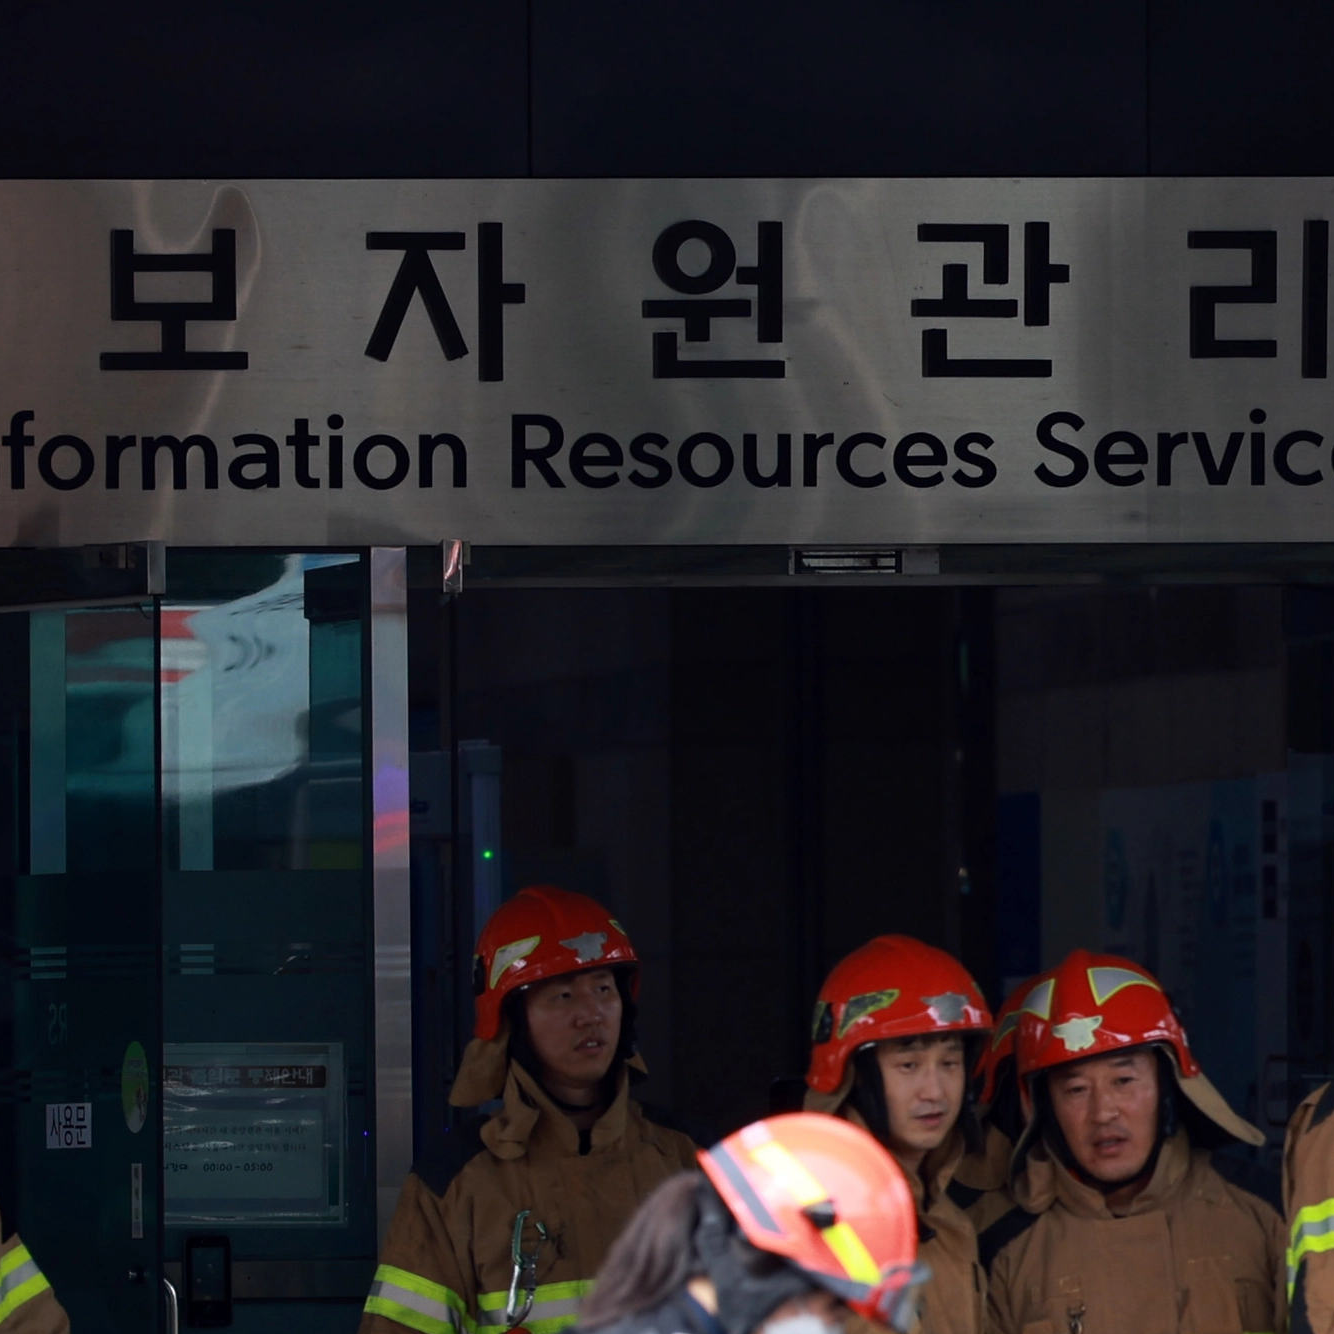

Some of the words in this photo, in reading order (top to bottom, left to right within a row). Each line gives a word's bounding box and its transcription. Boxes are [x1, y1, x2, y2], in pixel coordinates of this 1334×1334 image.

[511, 413, 997, 490] Resources
[49, 1105, 88, 1147] 사용문
[202, 1163, 233, 1172] 00:00
[243, 1163, 273, 1172] 05:00
